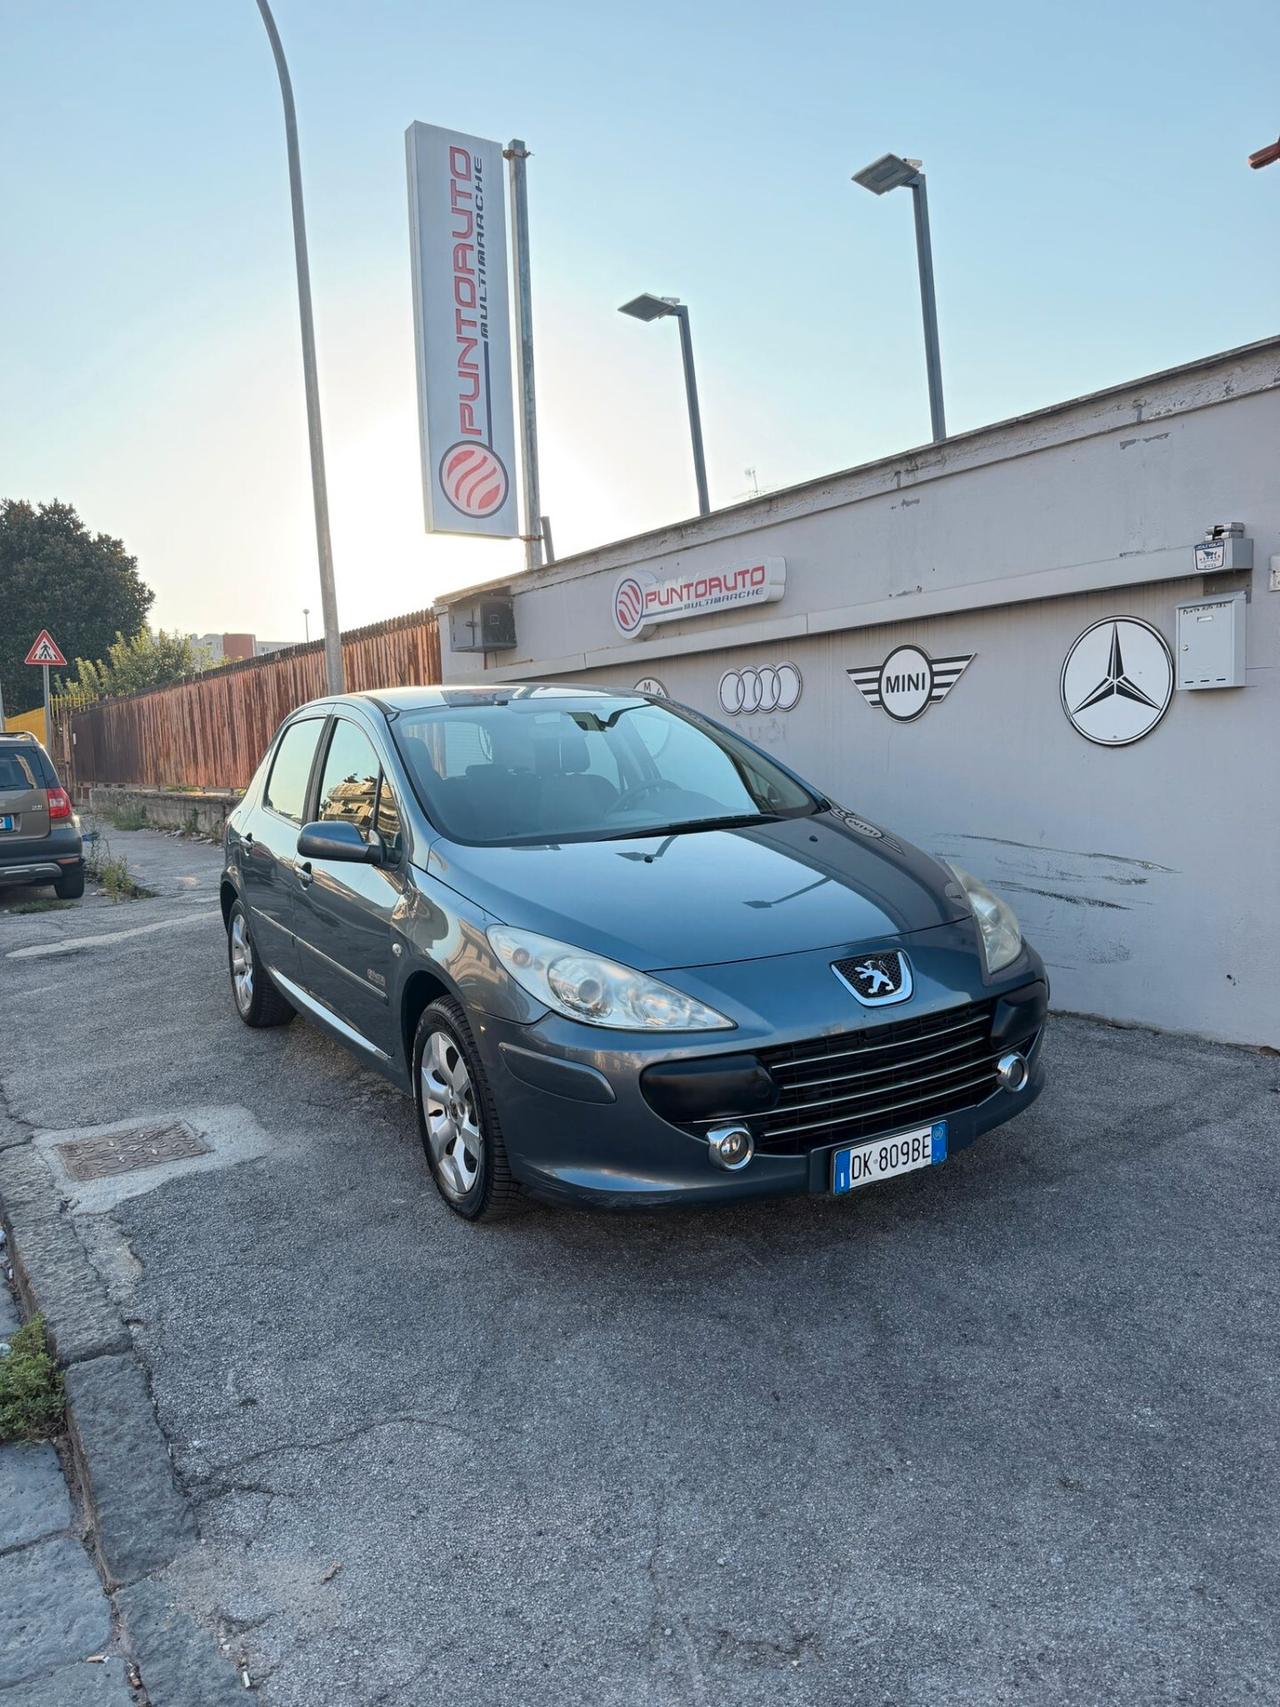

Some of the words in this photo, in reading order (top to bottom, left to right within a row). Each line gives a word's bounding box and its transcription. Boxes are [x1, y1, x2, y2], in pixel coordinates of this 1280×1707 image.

[473, 155, 490, 340] MULTIMARCHE
[449, 145, 482, 437] PUNTOAUTO
[645, 565, 766, 609] PUNTOAUTO
[683, 587, 765, 610] MULTIMARCHE
[885, 672, 926, 694] MINI
